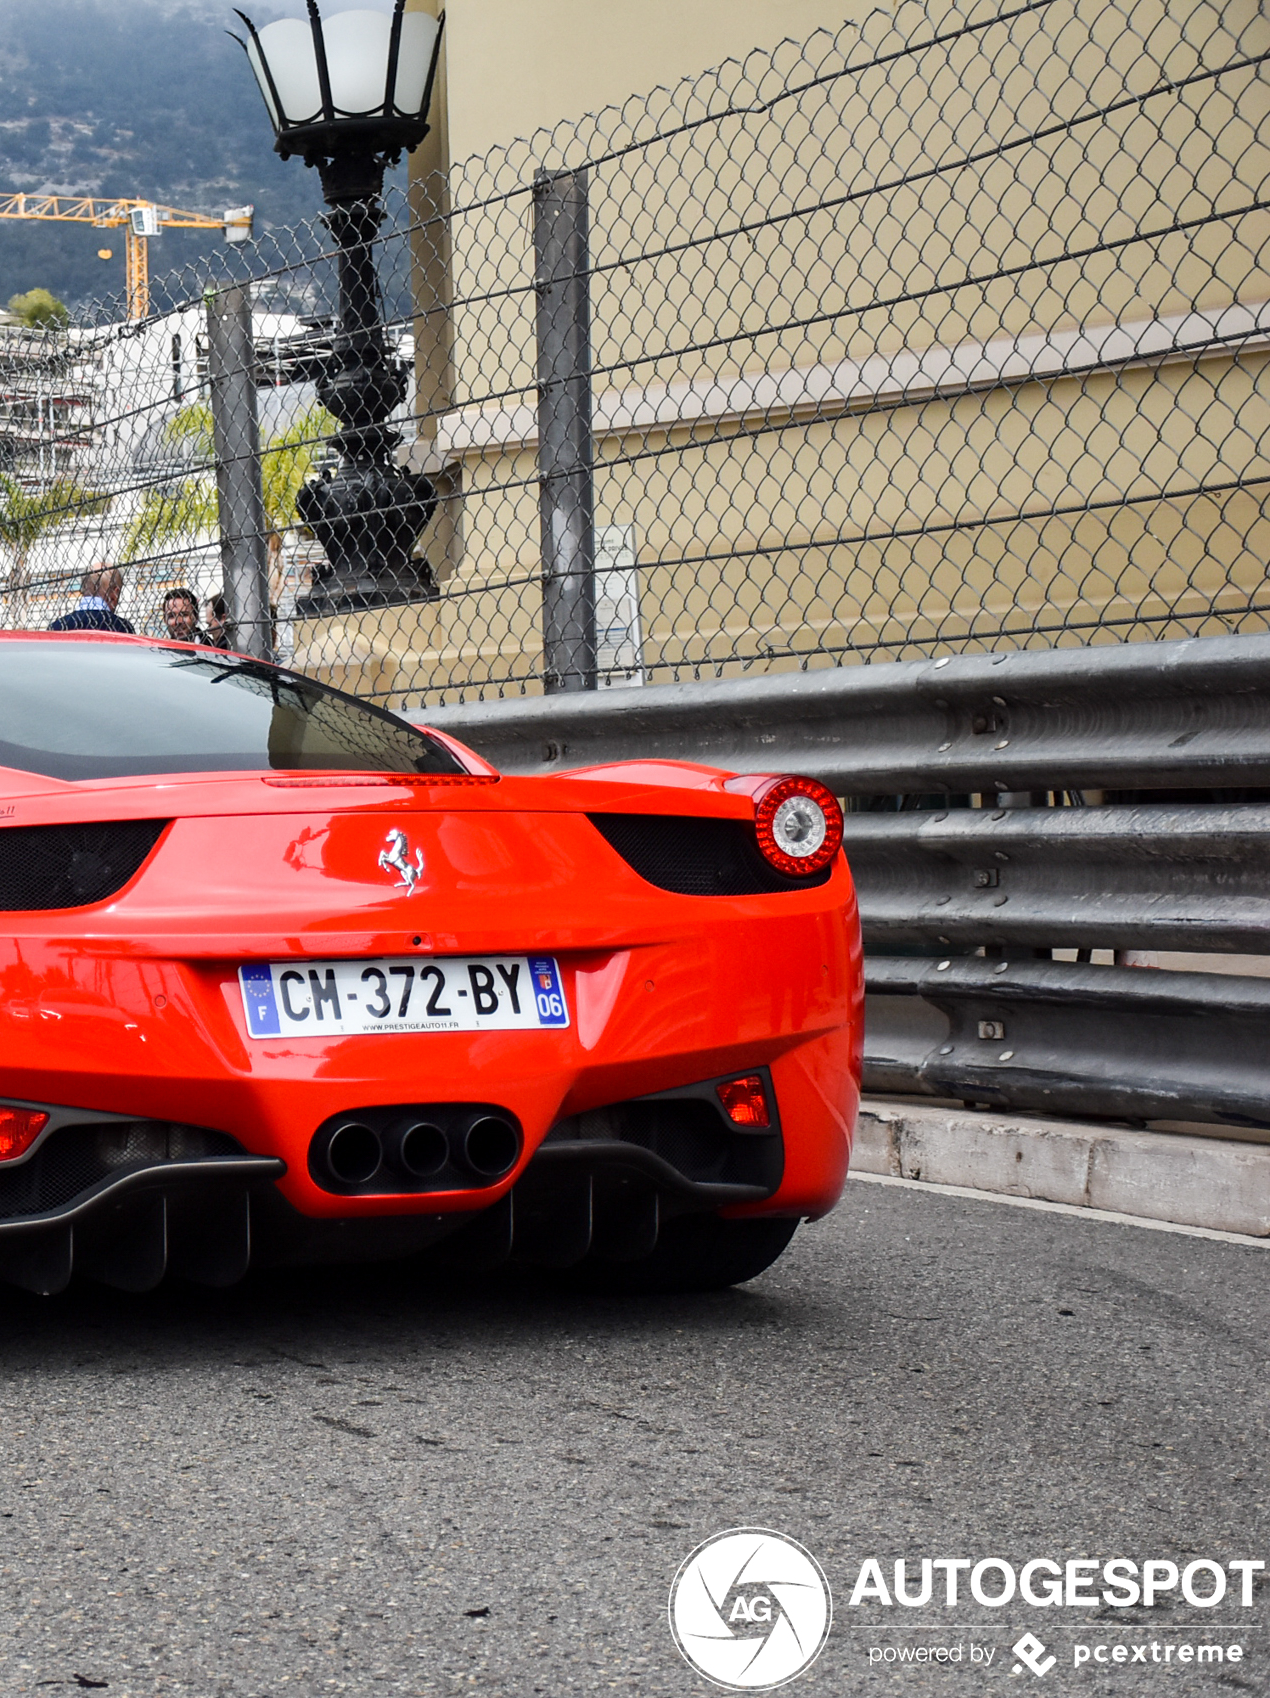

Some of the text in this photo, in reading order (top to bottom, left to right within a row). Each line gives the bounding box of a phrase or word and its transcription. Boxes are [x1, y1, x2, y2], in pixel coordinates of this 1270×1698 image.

[279, 964, 522, 1022] CM-372-BY
[258, 1006, 267, 1020] F
[536, 993, 563, 1017] 06
[362, 1022, 459, 1031] WWW.PRESTIGEAUTO11.FR
